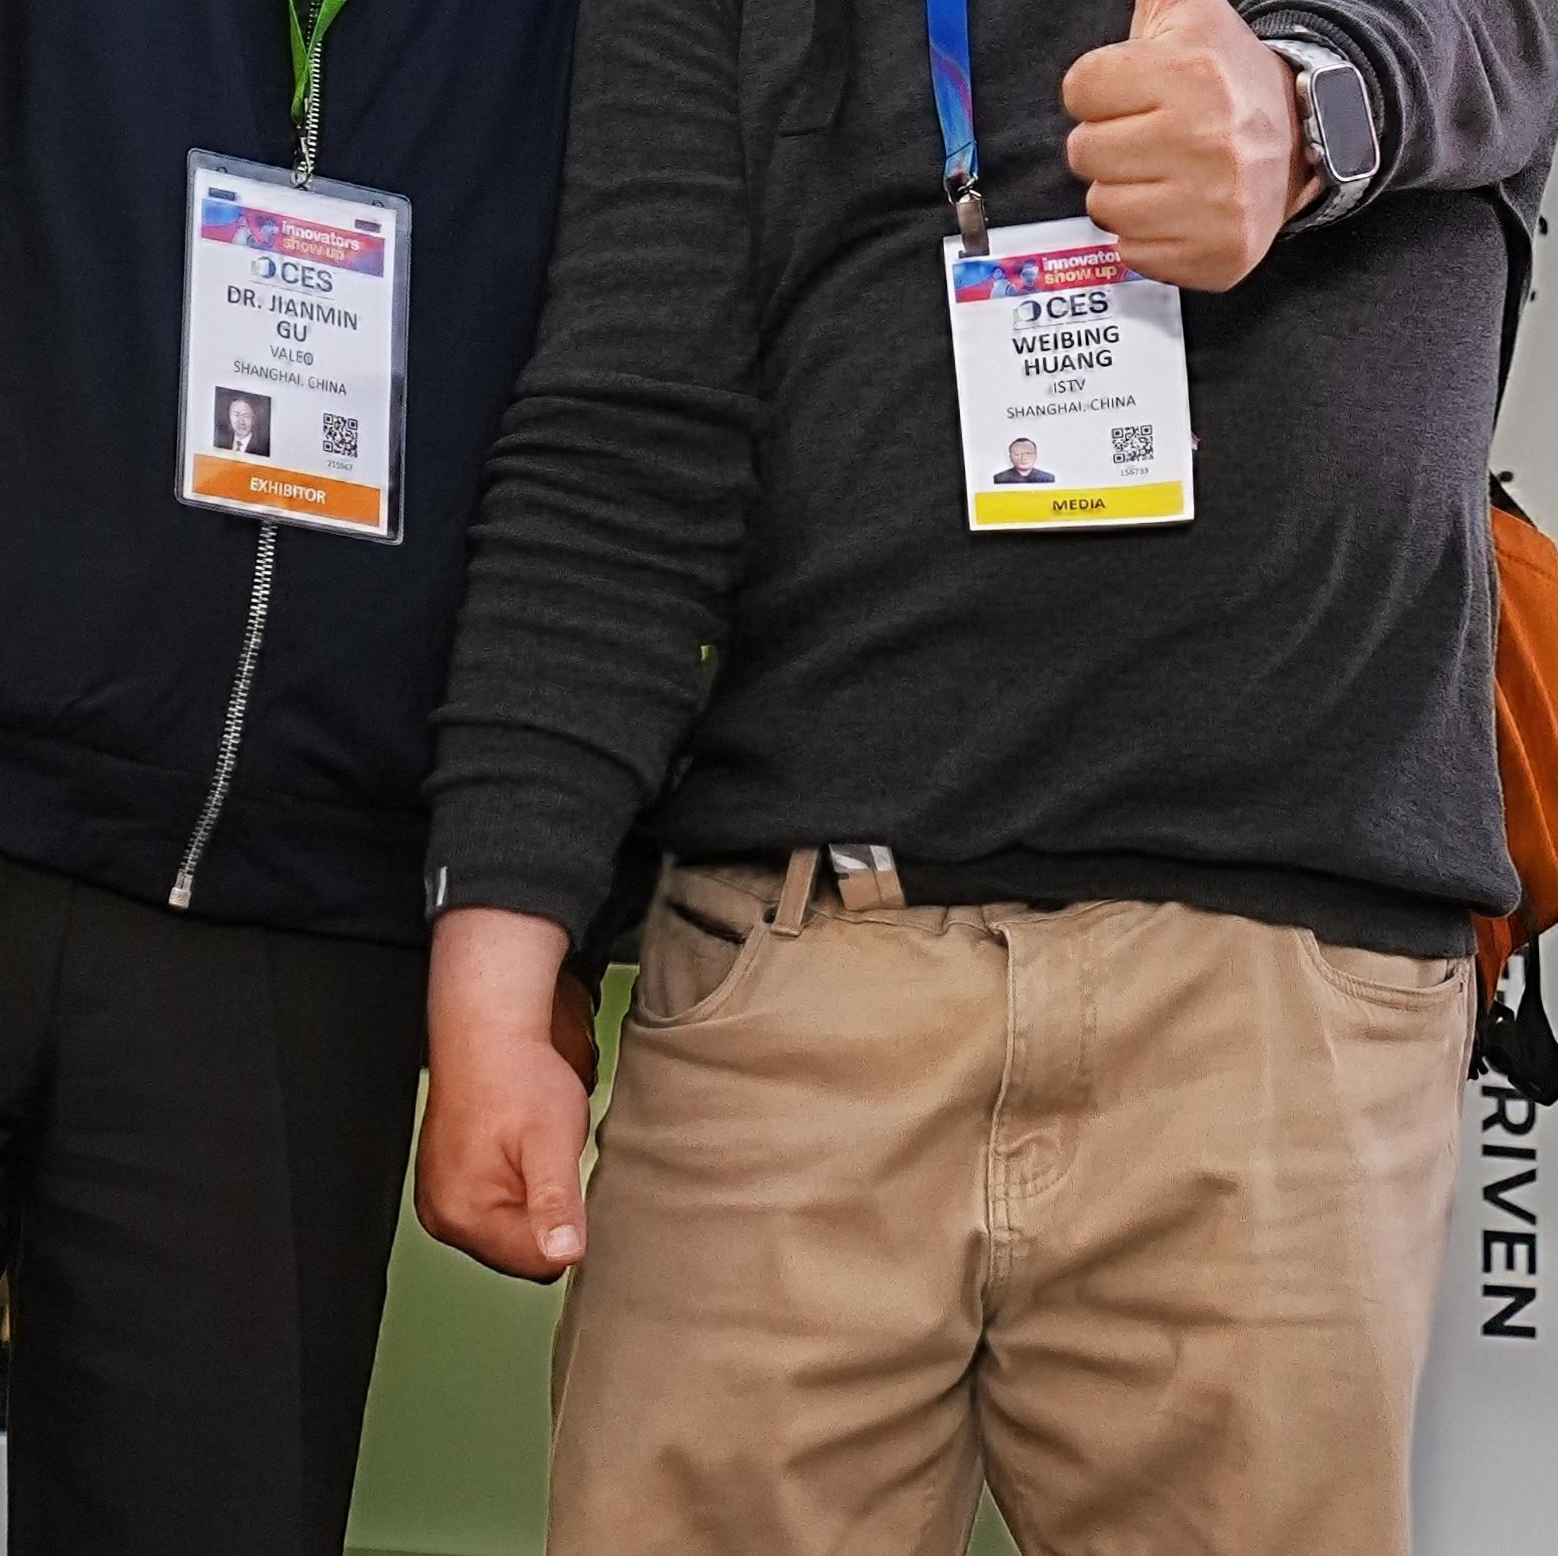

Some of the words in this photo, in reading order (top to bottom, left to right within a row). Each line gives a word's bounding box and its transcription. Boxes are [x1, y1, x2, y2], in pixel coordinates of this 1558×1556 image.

[281, 220, 361, 251] innovators
[282, 237, 323, 256] show
[328, 247, 345, 263] up
[1042, 250, 1121, 271] innovato
[280, 261, 333, 293] CES
[1044, 268, 1092, 285] show
[1095, 265, 1117, 280] up
[227, 285, 262, 309] DR.
[268, 294, 358, 331] JIANMIN
[1046, 291, 1109, 319] CES
[276, 320, 308, 342] GU
[1012, 325, 1120, 355] WEIBING
[269, 344, 314, 366] VALEO
[1024, 349, 1113, 376] HUANG
[307, 376, 347, 396] CHINA
[1090, 394, 1137, 411] CHINA
[249, 476, 327, 505] EXHIBITOR
[1052, 497, 1106, 512] MEDIA
[1480, 1084, 1538, 1341] RIVEN
